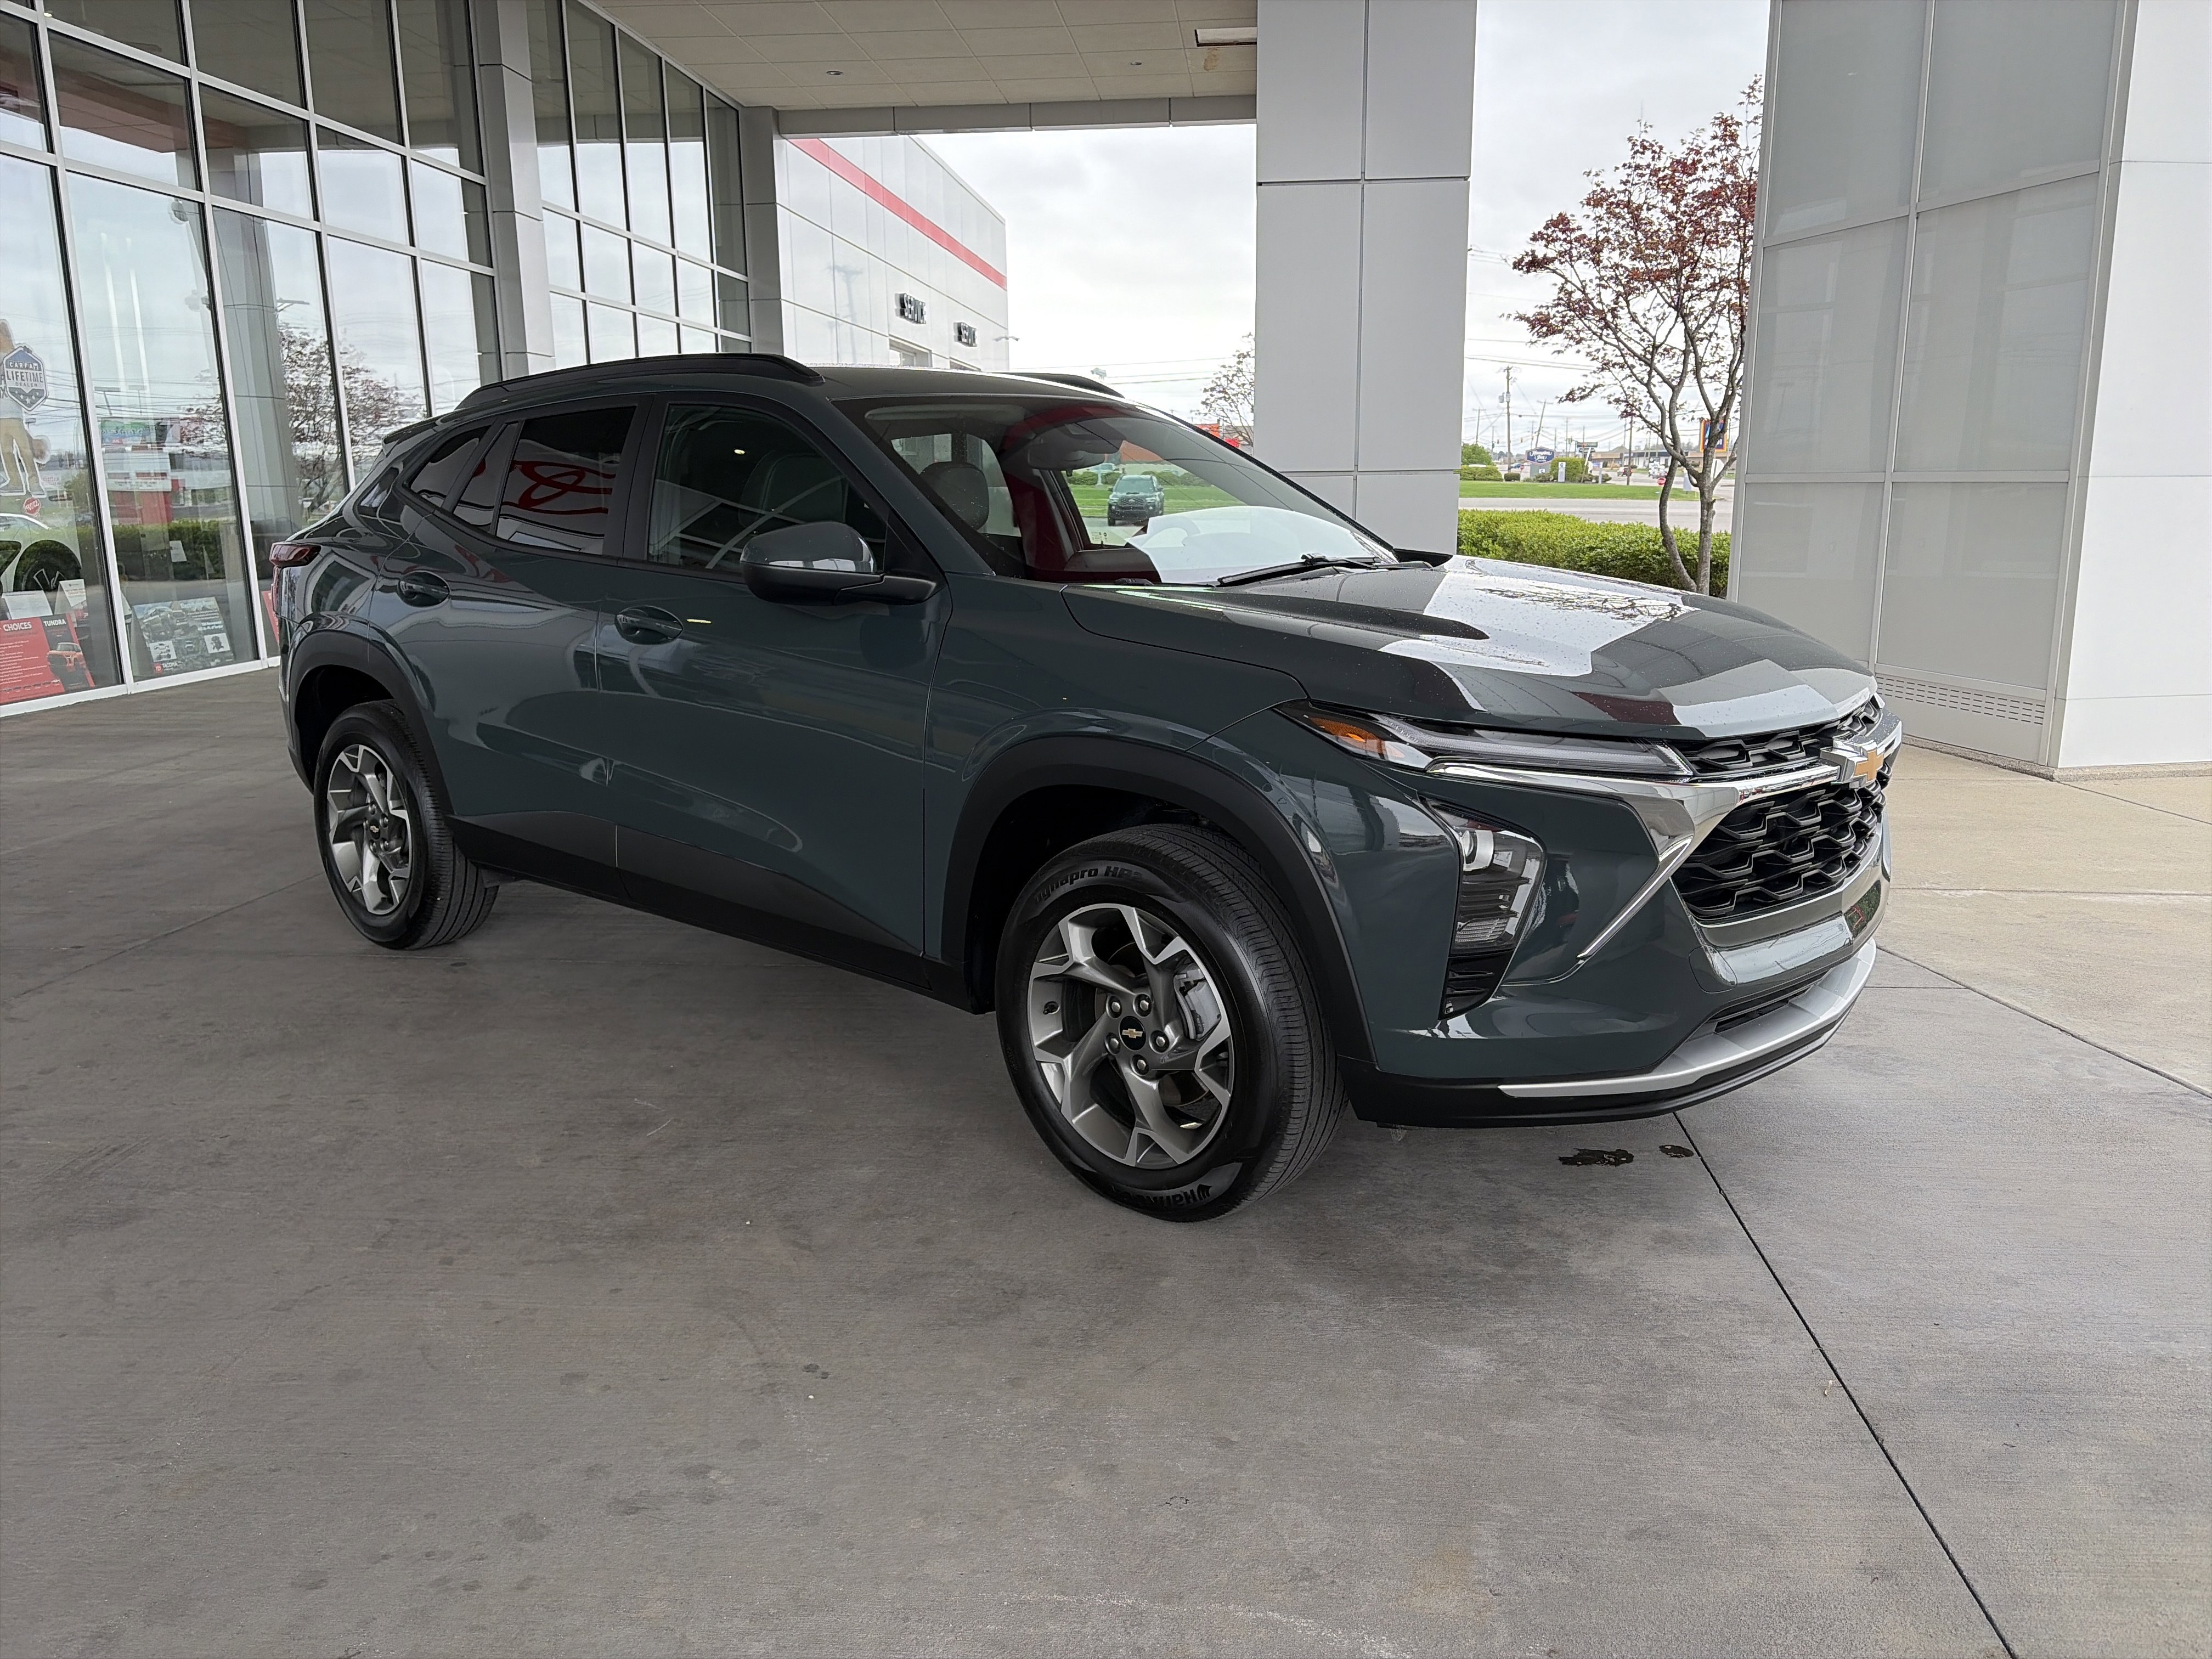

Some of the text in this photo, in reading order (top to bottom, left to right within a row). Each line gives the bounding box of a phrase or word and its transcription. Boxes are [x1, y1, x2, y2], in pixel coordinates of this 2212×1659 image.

[9, 362, 39, 370] CARFAX
[6, 370, 43, 383] LIFETIME
[3, 622, 32, 631] CHOICES
